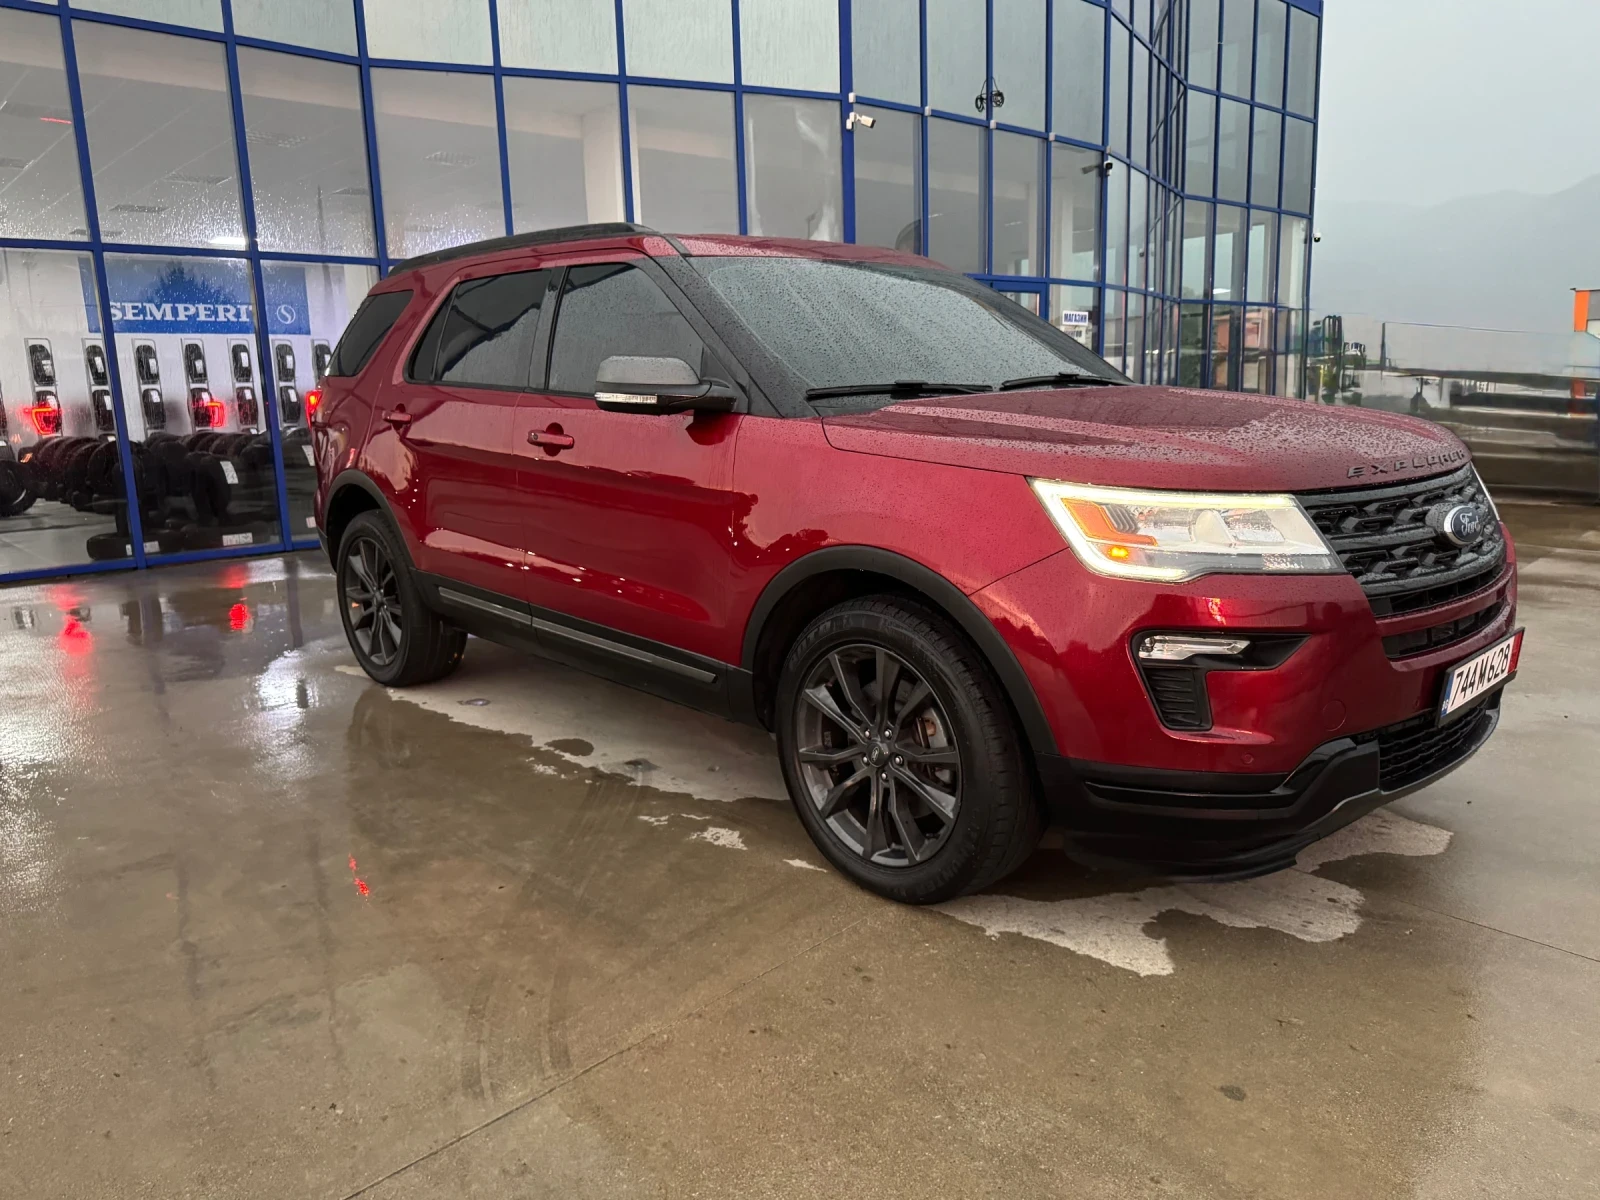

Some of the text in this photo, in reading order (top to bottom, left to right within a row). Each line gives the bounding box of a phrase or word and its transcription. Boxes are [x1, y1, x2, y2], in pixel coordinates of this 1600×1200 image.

[109, 302, 253, 322] SEMPERI
[1064, 313, 1087, 323] МАГАЗИН
[1460, 512, 1480, 536] Ford
[1451, 643, 1510, 707] 744M628
